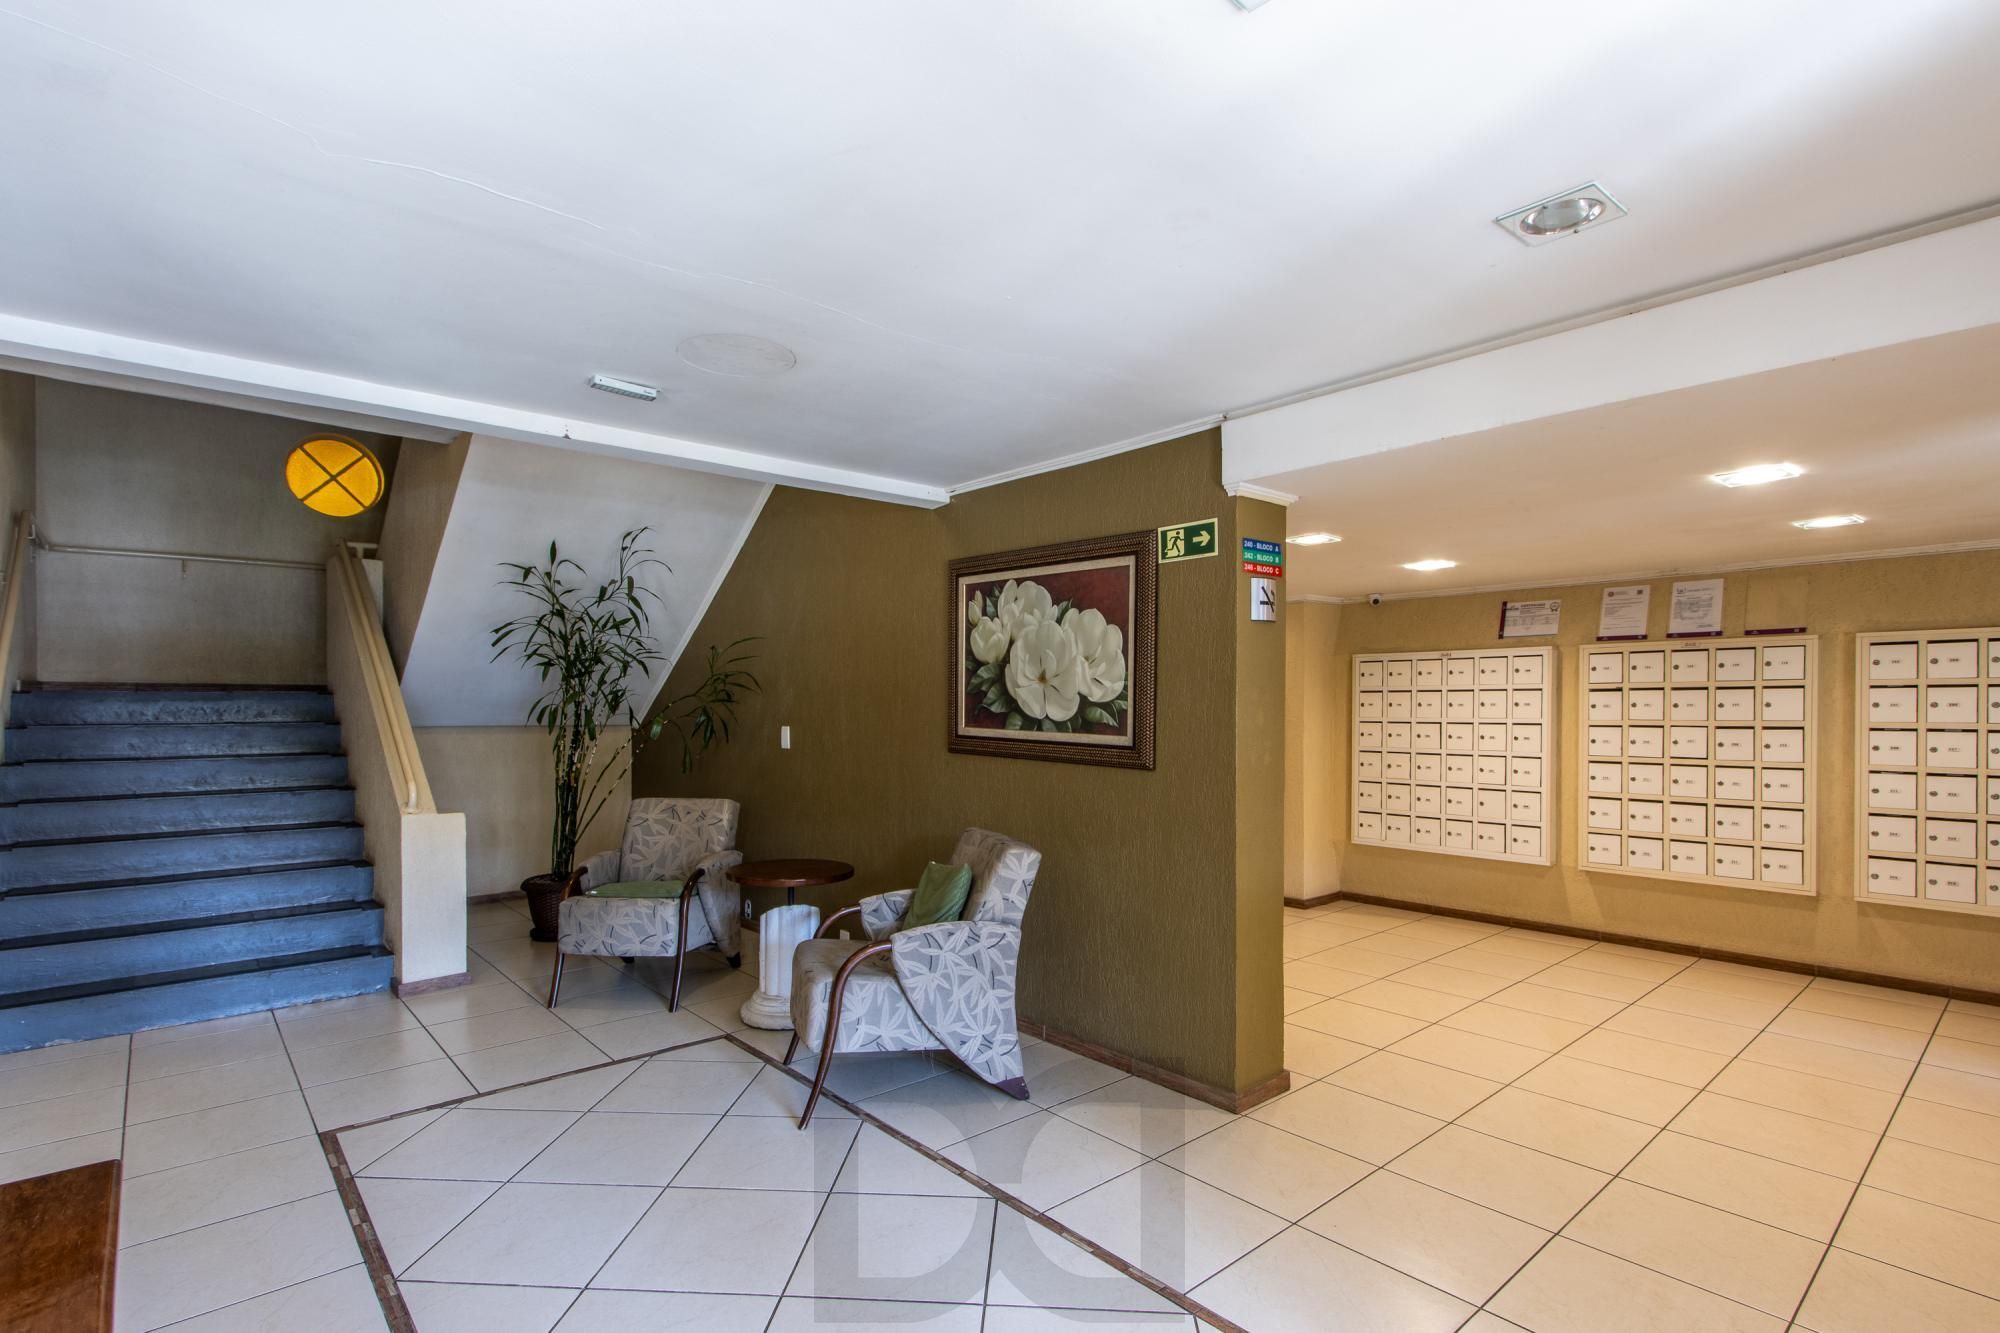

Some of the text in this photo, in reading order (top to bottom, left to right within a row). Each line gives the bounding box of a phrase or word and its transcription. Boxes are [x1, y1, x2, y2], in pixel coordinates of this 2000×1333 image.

[1256, 542, 1273, 552] BLOCO
[1256, 554, 1273, 563] BLOCO
[1256, 564, 1273, 574] BLOCO
